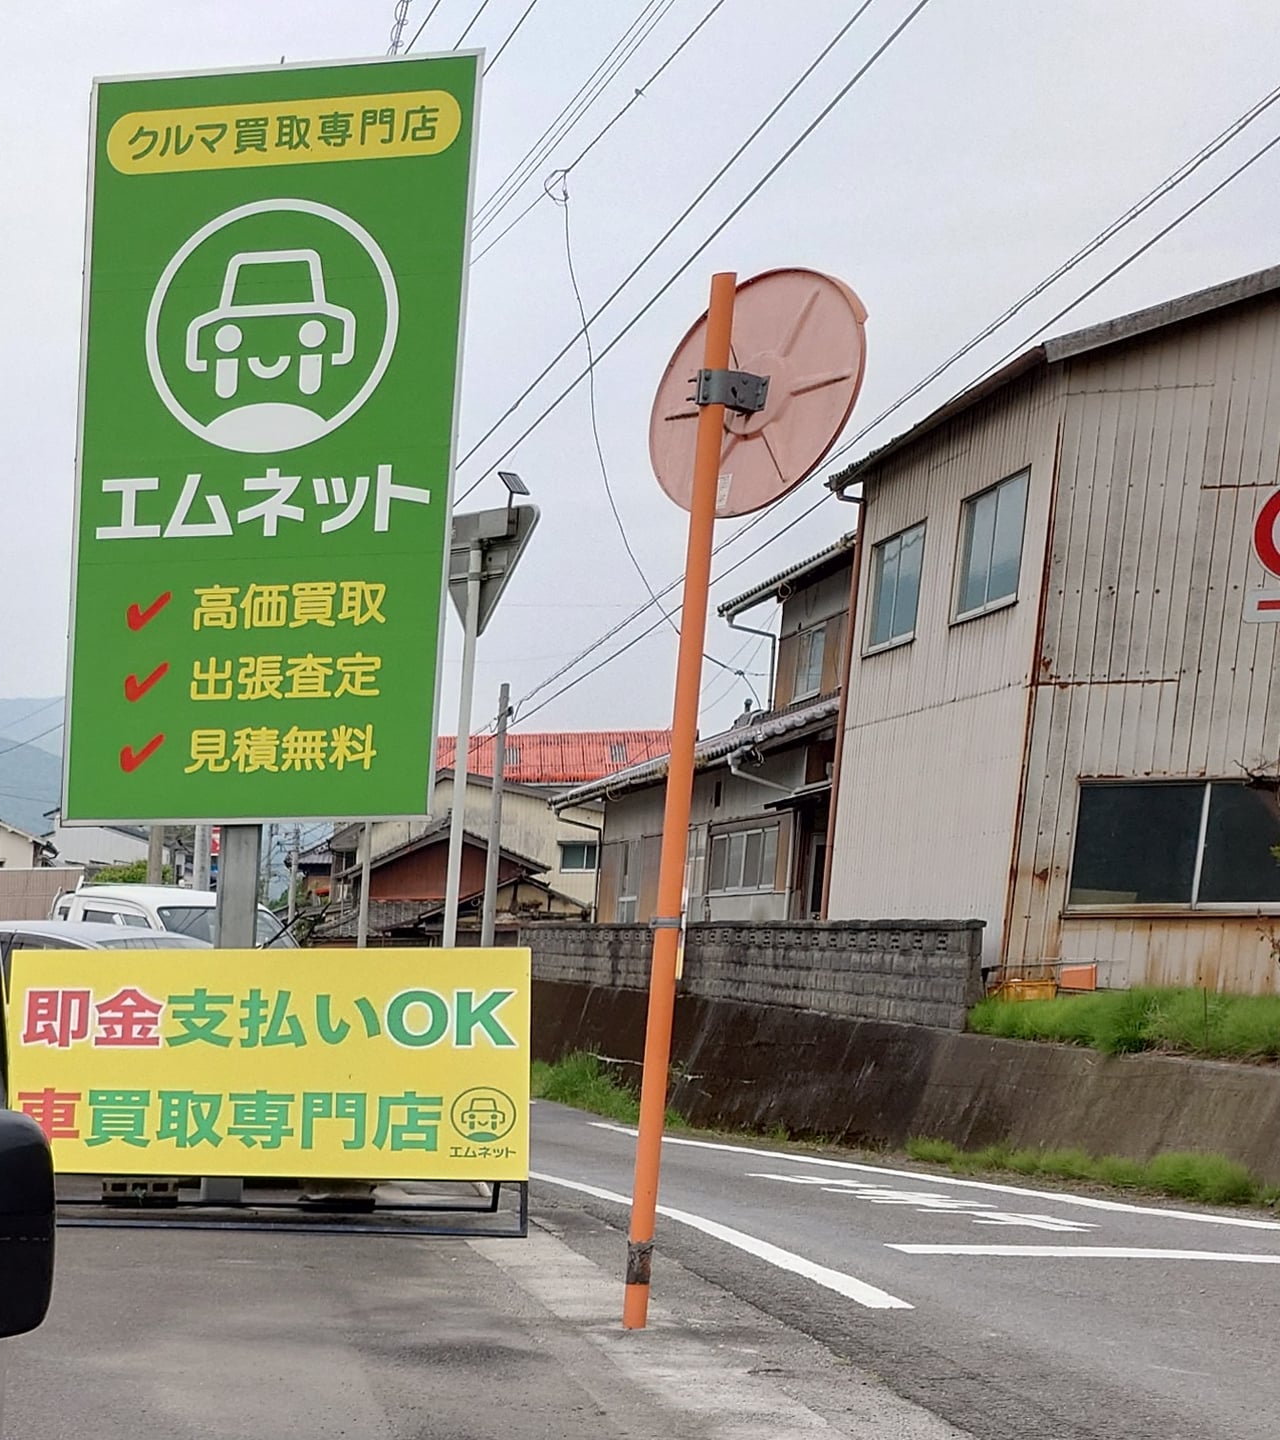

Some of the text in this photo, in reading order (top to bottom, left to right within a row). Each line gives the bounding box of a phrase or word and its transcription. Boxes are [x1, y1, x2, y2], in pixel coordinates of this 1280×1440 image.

[127, 105, 440, 161] クルマ買取専門店
[95, 464, 431, 540] エムネット
[192, 581, 387, 631] 高価買取
[189, 652, 382, 701] 出張査定
[184, 724, 377, 773] 見積無料
[21, 987, 518, 1049] 即金支払いOK
[17, 1087, 444, 1151] 車買取専門店
[449, 1146, 517, 1158] エムネット
